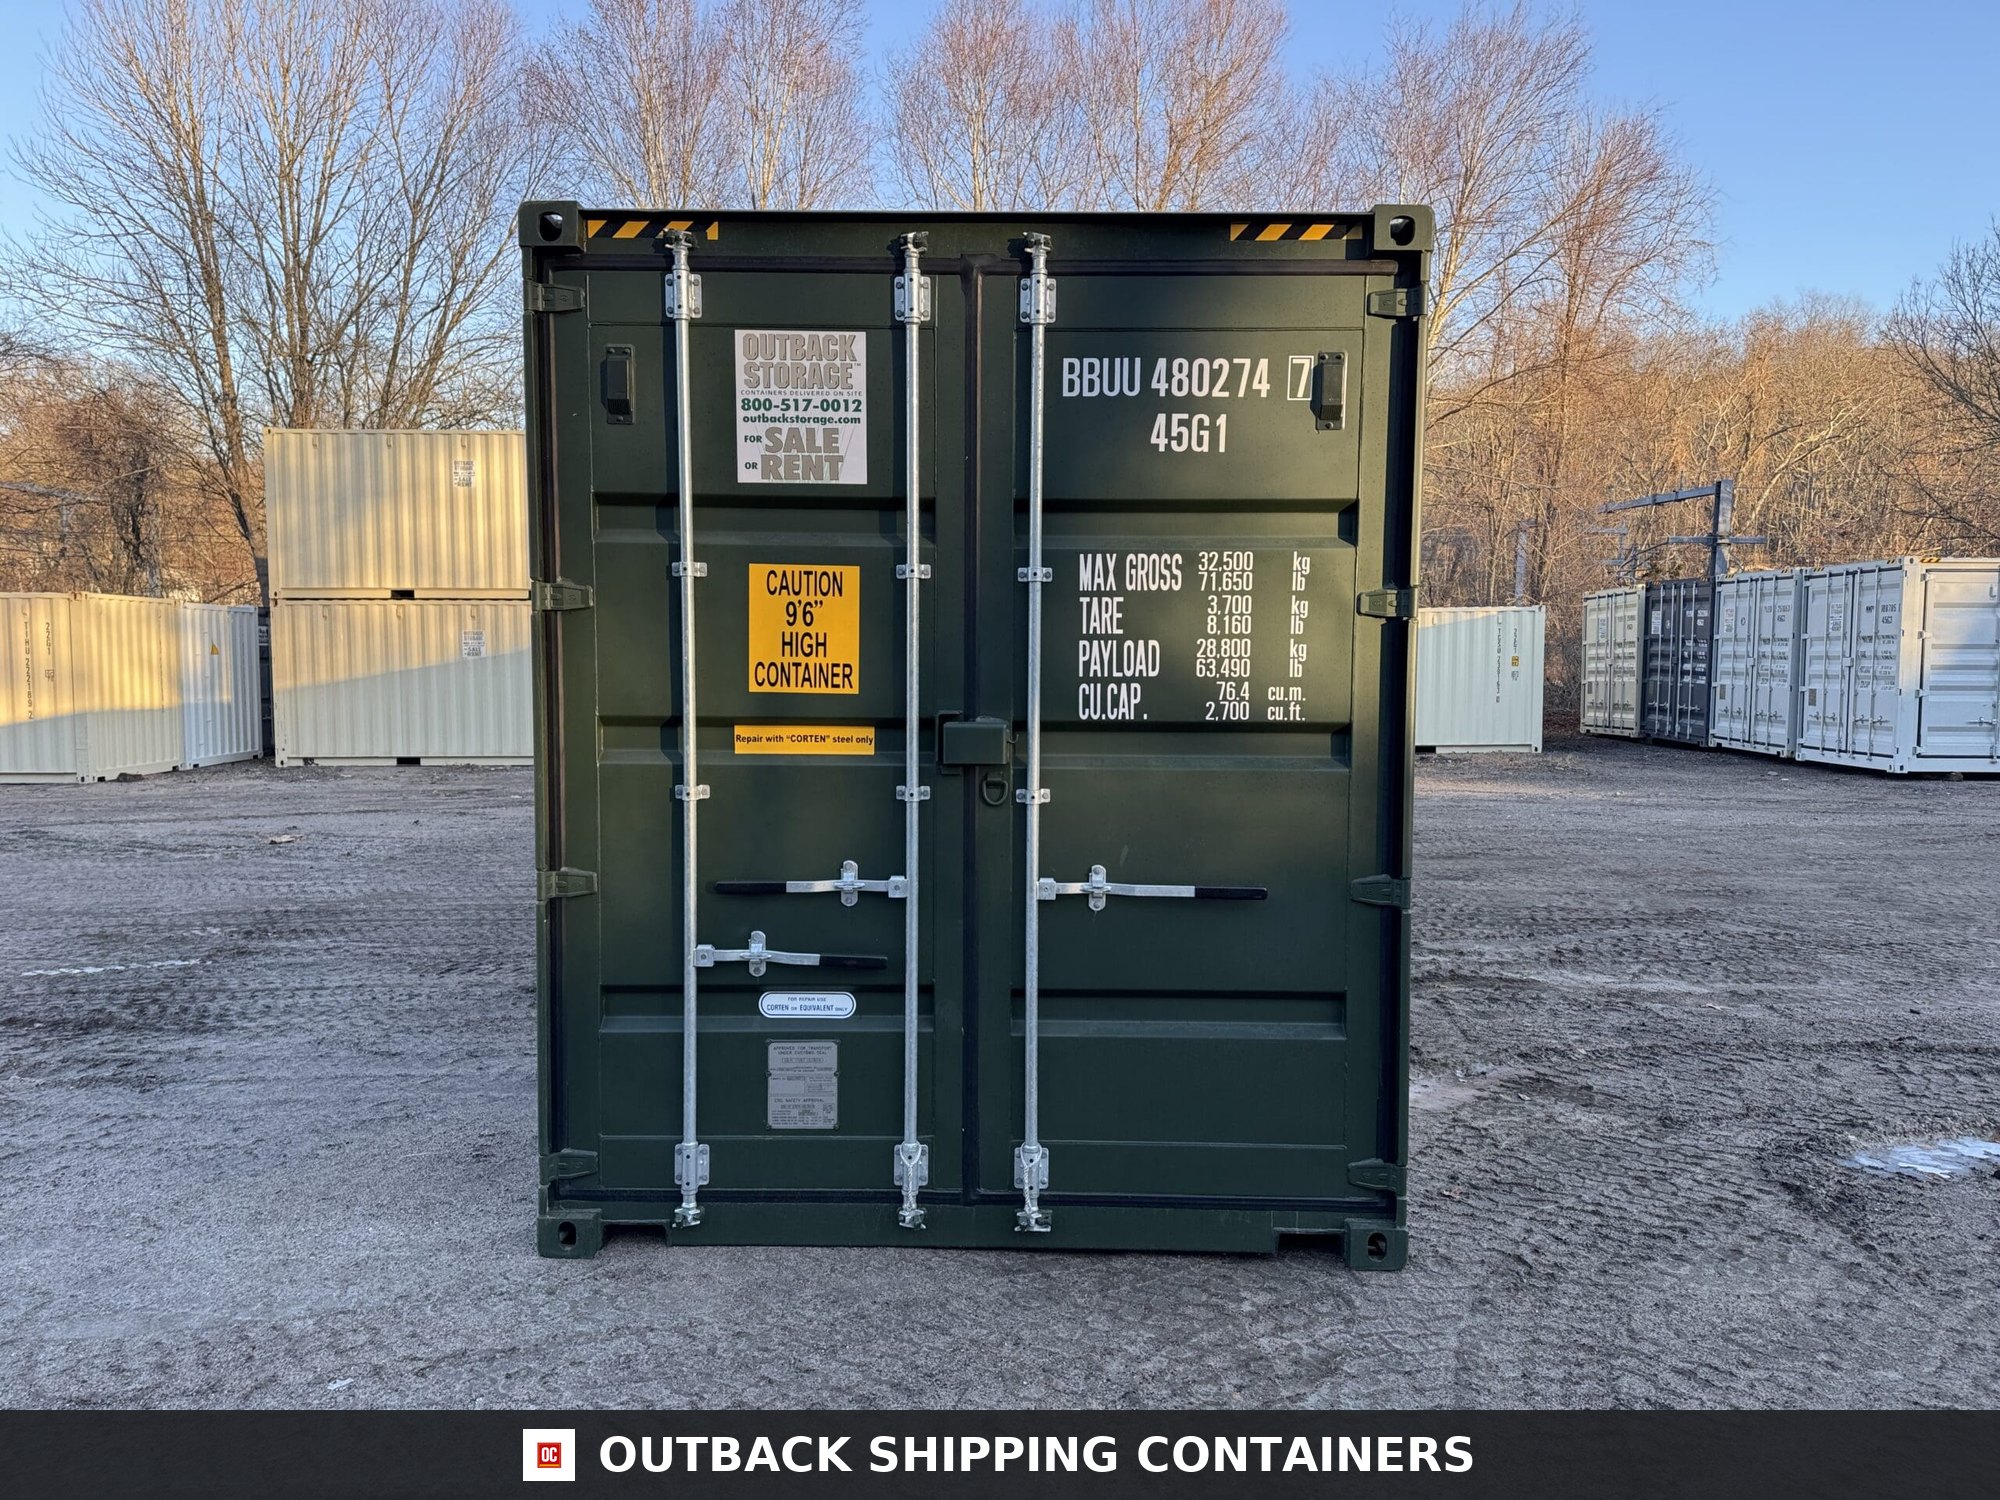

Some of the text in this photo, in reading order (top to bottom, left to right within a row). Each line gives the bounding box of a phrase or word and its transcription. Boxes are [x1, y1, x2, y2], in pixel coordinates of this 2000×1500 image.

[742, 334, 857, 361] OUTBACK
[744, 362, 853, 390] STORAGE
[1062, 357, 1310, 398] BBUU 480274 7
[741, 398, 862, 412] 800-517-0012
[742, 413, 861, 426] outbackstorage.com
[1150, 413, 1227, 452] 45G1
[744, 426, 840, 453] FOR SALE
[760, 454, 844, 481] RENT
[766, 569, 843, 597] CAUTION
[1079, 552, 1310, 591] MAX GROSS 32,500 kg
[1198, 572, 1305, 592] 71,650 lb
[1079, 595, 1308, 634] TARE 3,700 kg
[1207, 615, 1303, 636] 8,160 lb
[781, 631, 827, 657] HIGH
[1078, 638, 1307, 677] PAYLOAD 28,800 kg
[754, 662, 854, 689] CONTAINER
[1196, 658, 1302, 678] 63,490 lb
[1216, 681, 1250, 700] 76.4
[1267, 685, 1306, 701] cu.m.
[1205, 702, 1306, 721] 2,700 cu.ft.
[736, 734, 763, 744] Repair
[832, 735, 853, 743] steel
[856, 735, 873, 745] only
